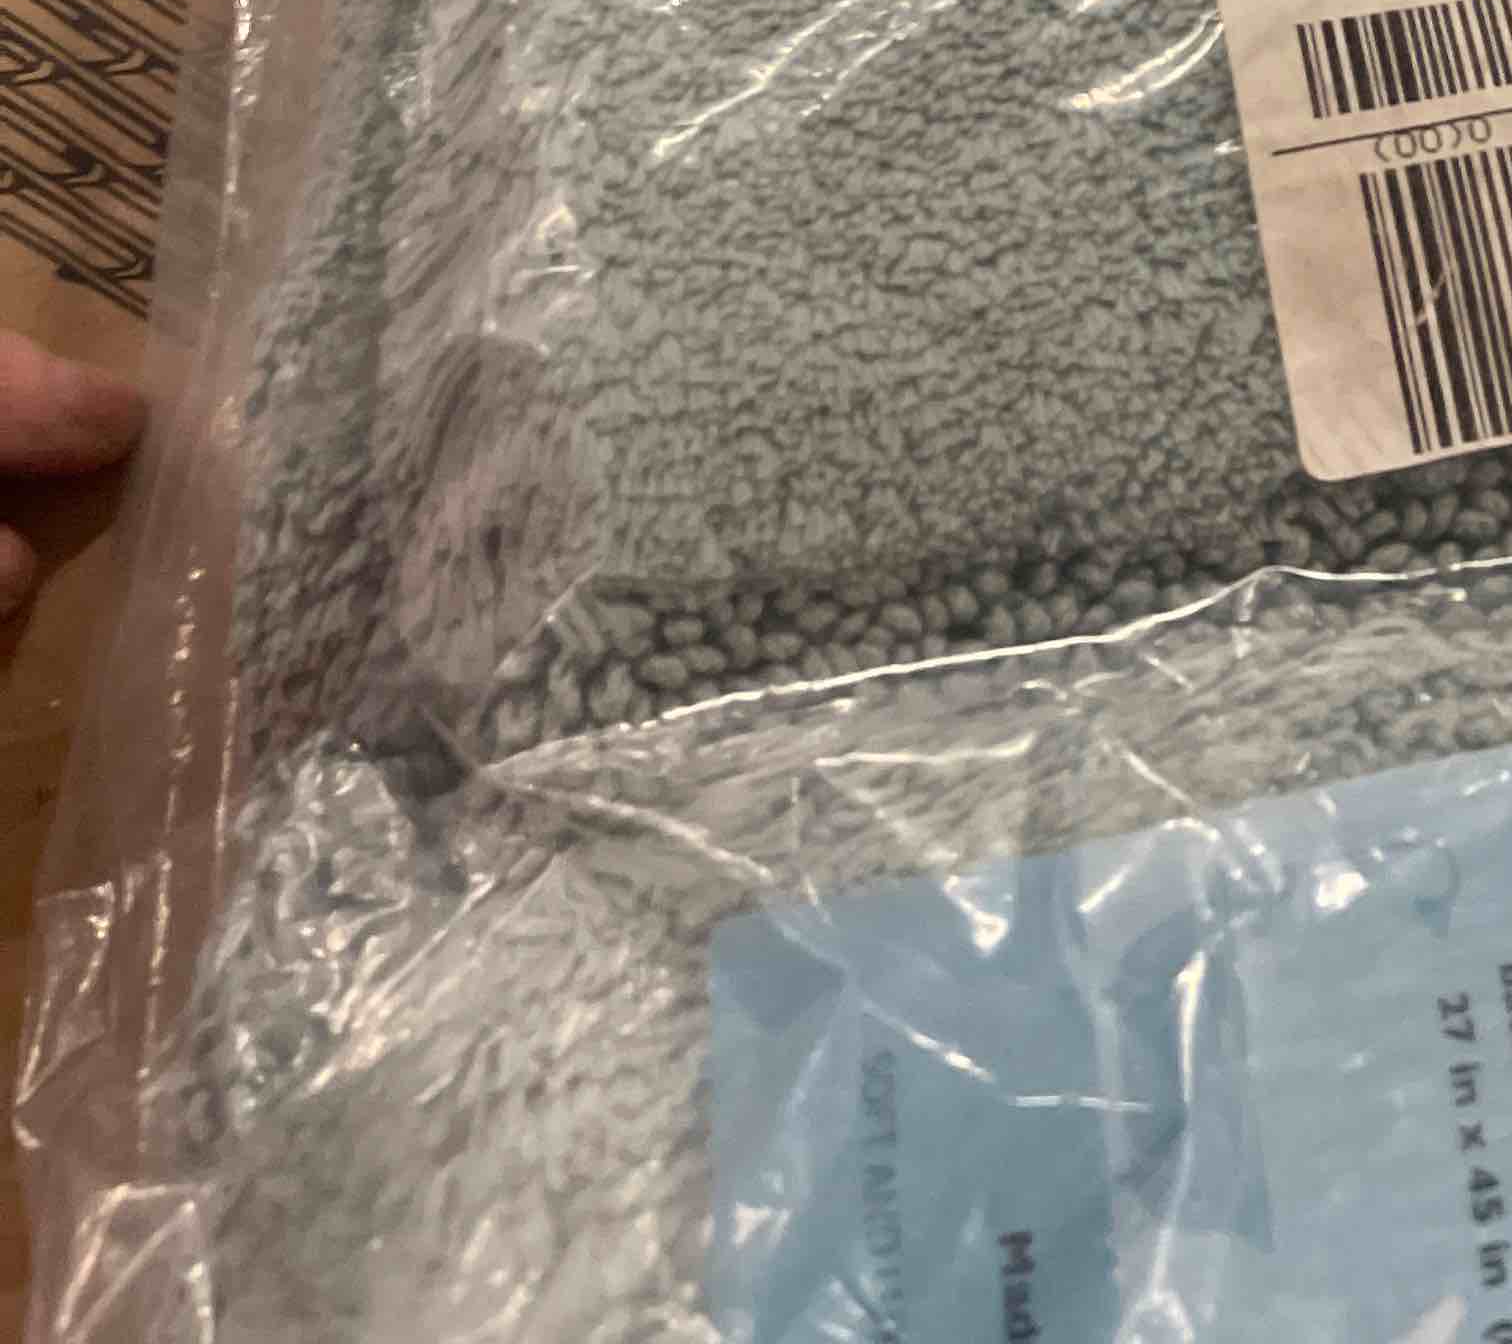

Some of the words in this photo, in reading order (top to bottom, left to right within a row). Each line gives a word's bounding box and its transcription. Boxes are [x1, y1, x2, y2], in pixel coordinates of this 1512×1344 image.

[1436, 991, 1477, 1042] 27
[1448, 1060, 1482, 1107] in
[1467, 1166, 1506, 1224] 45
[1477, 1239, 1512, 1288] in
